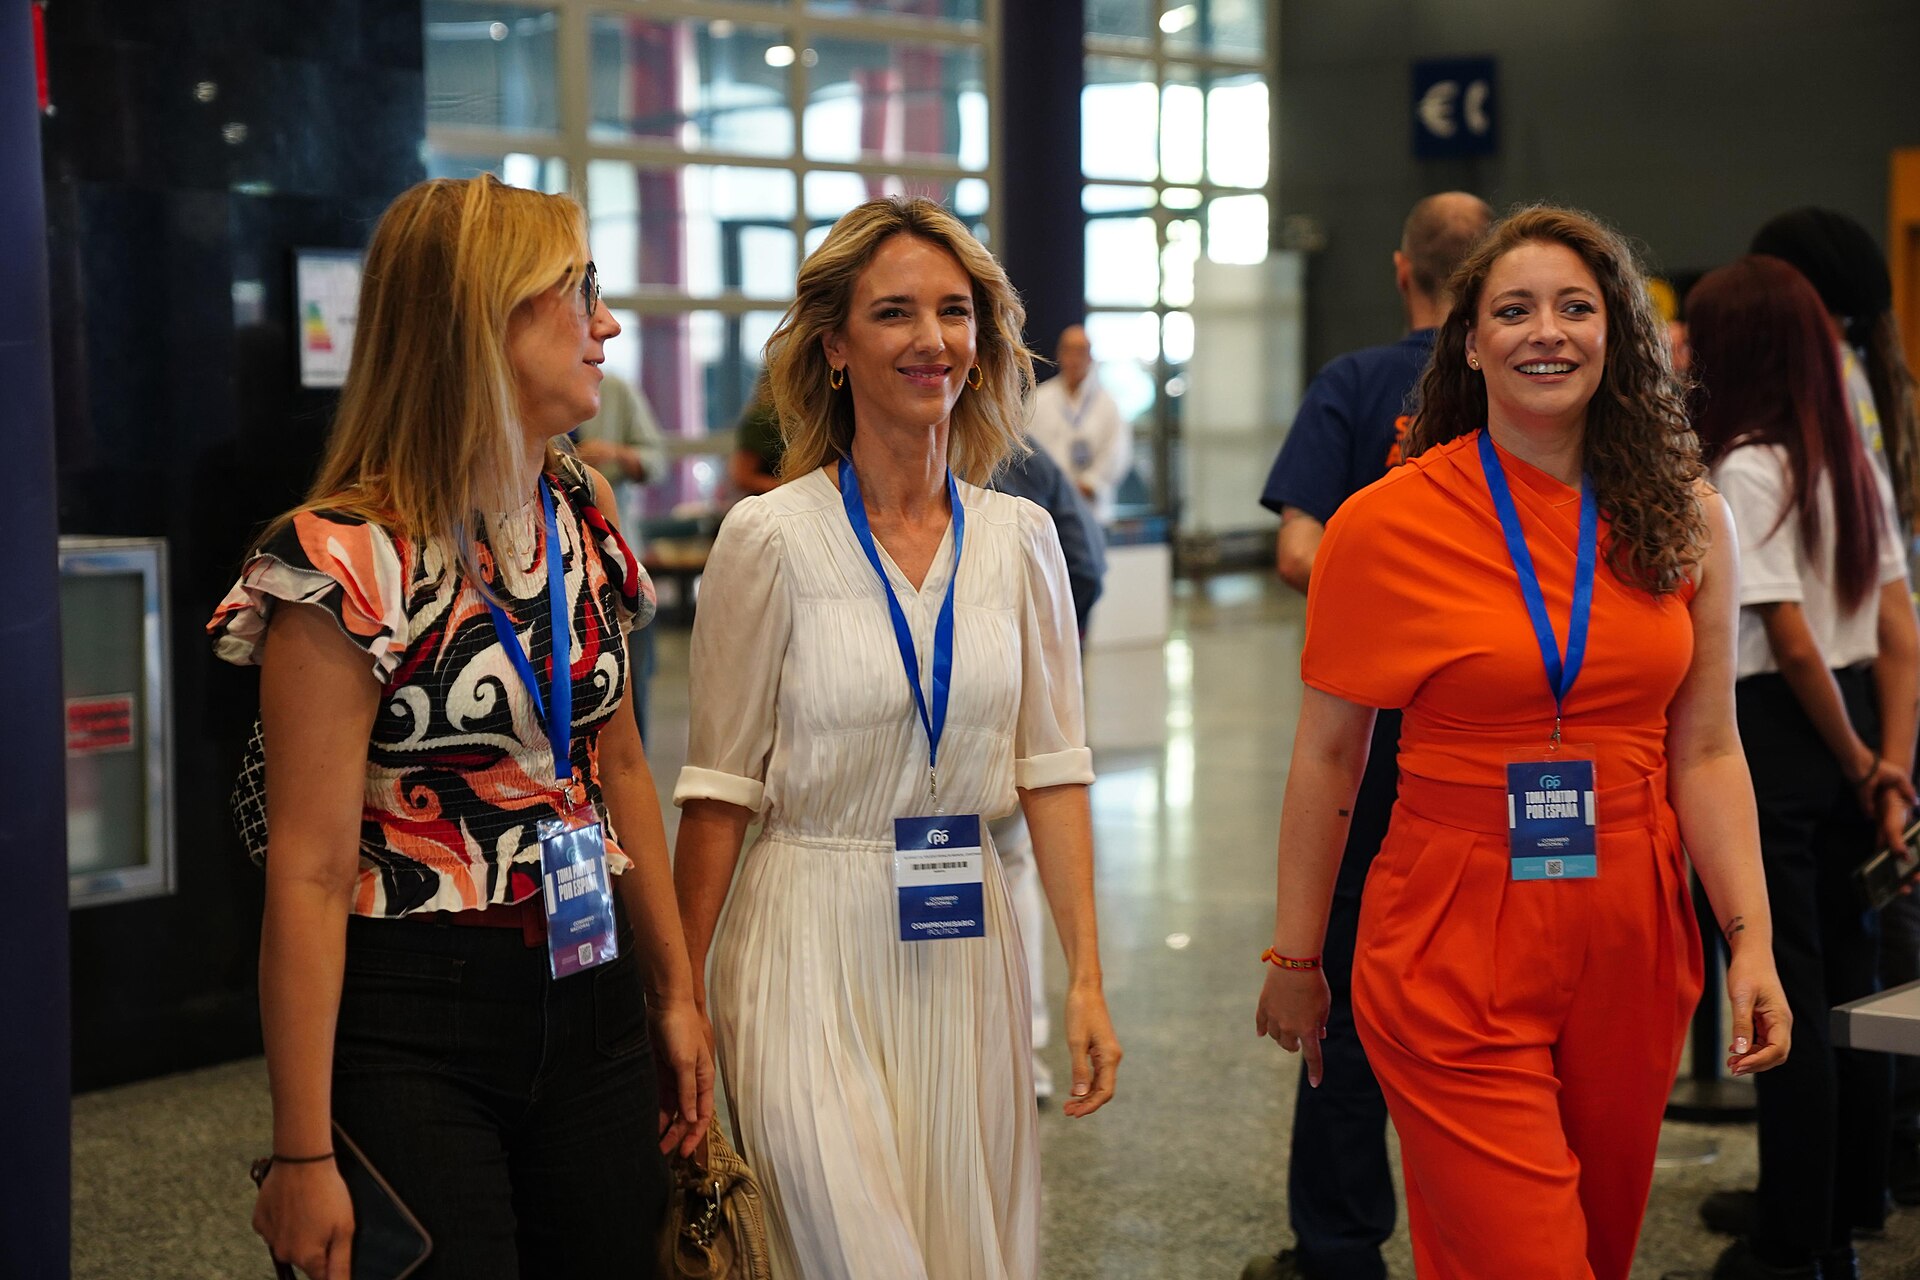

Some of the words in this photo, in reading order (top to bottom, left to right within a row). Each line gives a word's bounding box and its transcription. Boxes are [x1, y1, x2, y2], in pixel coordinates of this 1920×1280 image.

[1525, 791, 1546, 804] TOMA
[1546, 790, 1578, 803] PARTIDO
[1526, 804, 1545, 819] POR
[1545, 802, 1578, 818] ESPAÑA
[556, 866, 573, 884] TOMA
[558, 881, 574, 902] POR
[911, 919, 976, 930] COMPROMISARIO
